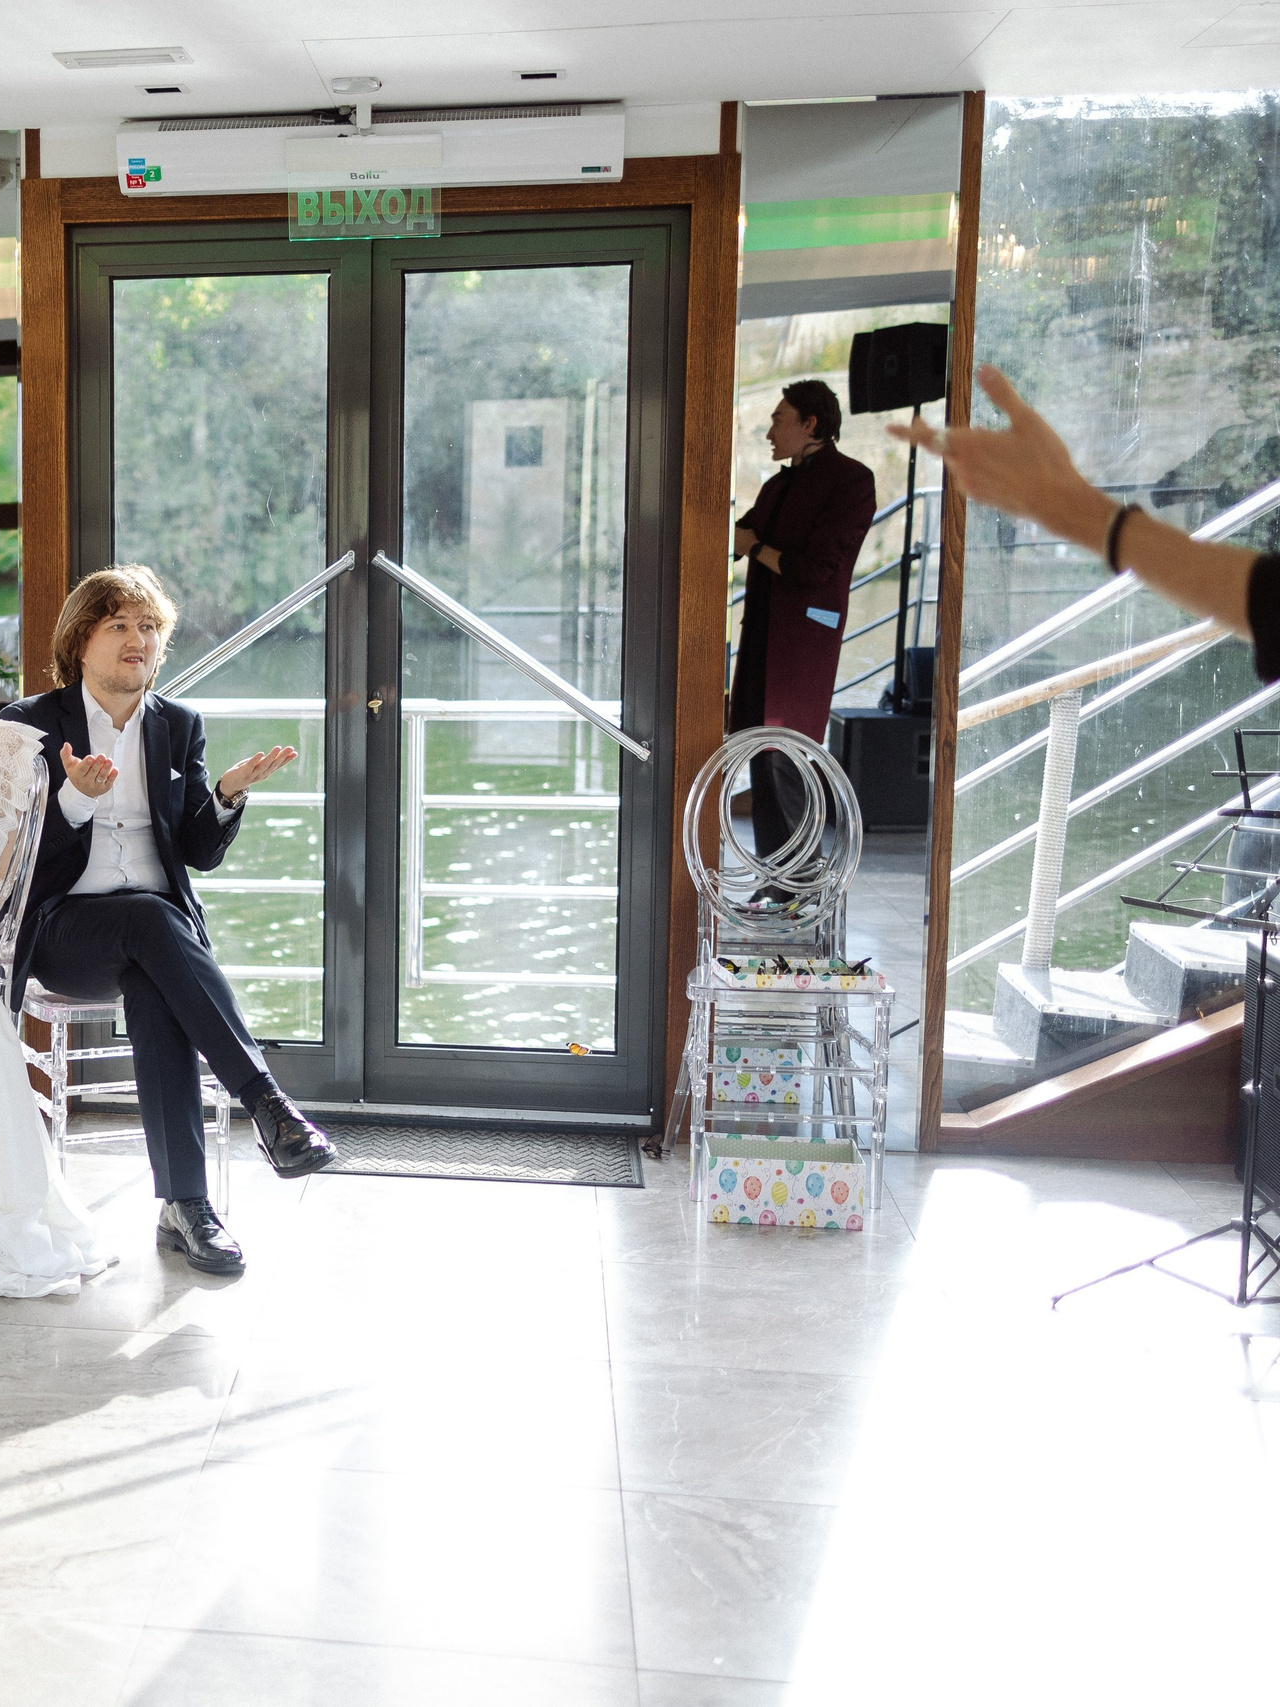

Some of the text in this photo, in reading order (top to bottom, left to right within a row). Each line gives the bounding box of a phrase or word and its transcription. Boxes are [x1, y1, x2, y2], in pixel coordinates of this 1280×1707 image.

[149, 170, 155, 178] 2
[350, 170, 380, 180] Ballu
[297, 188, 435, 231] ВЫХОД
